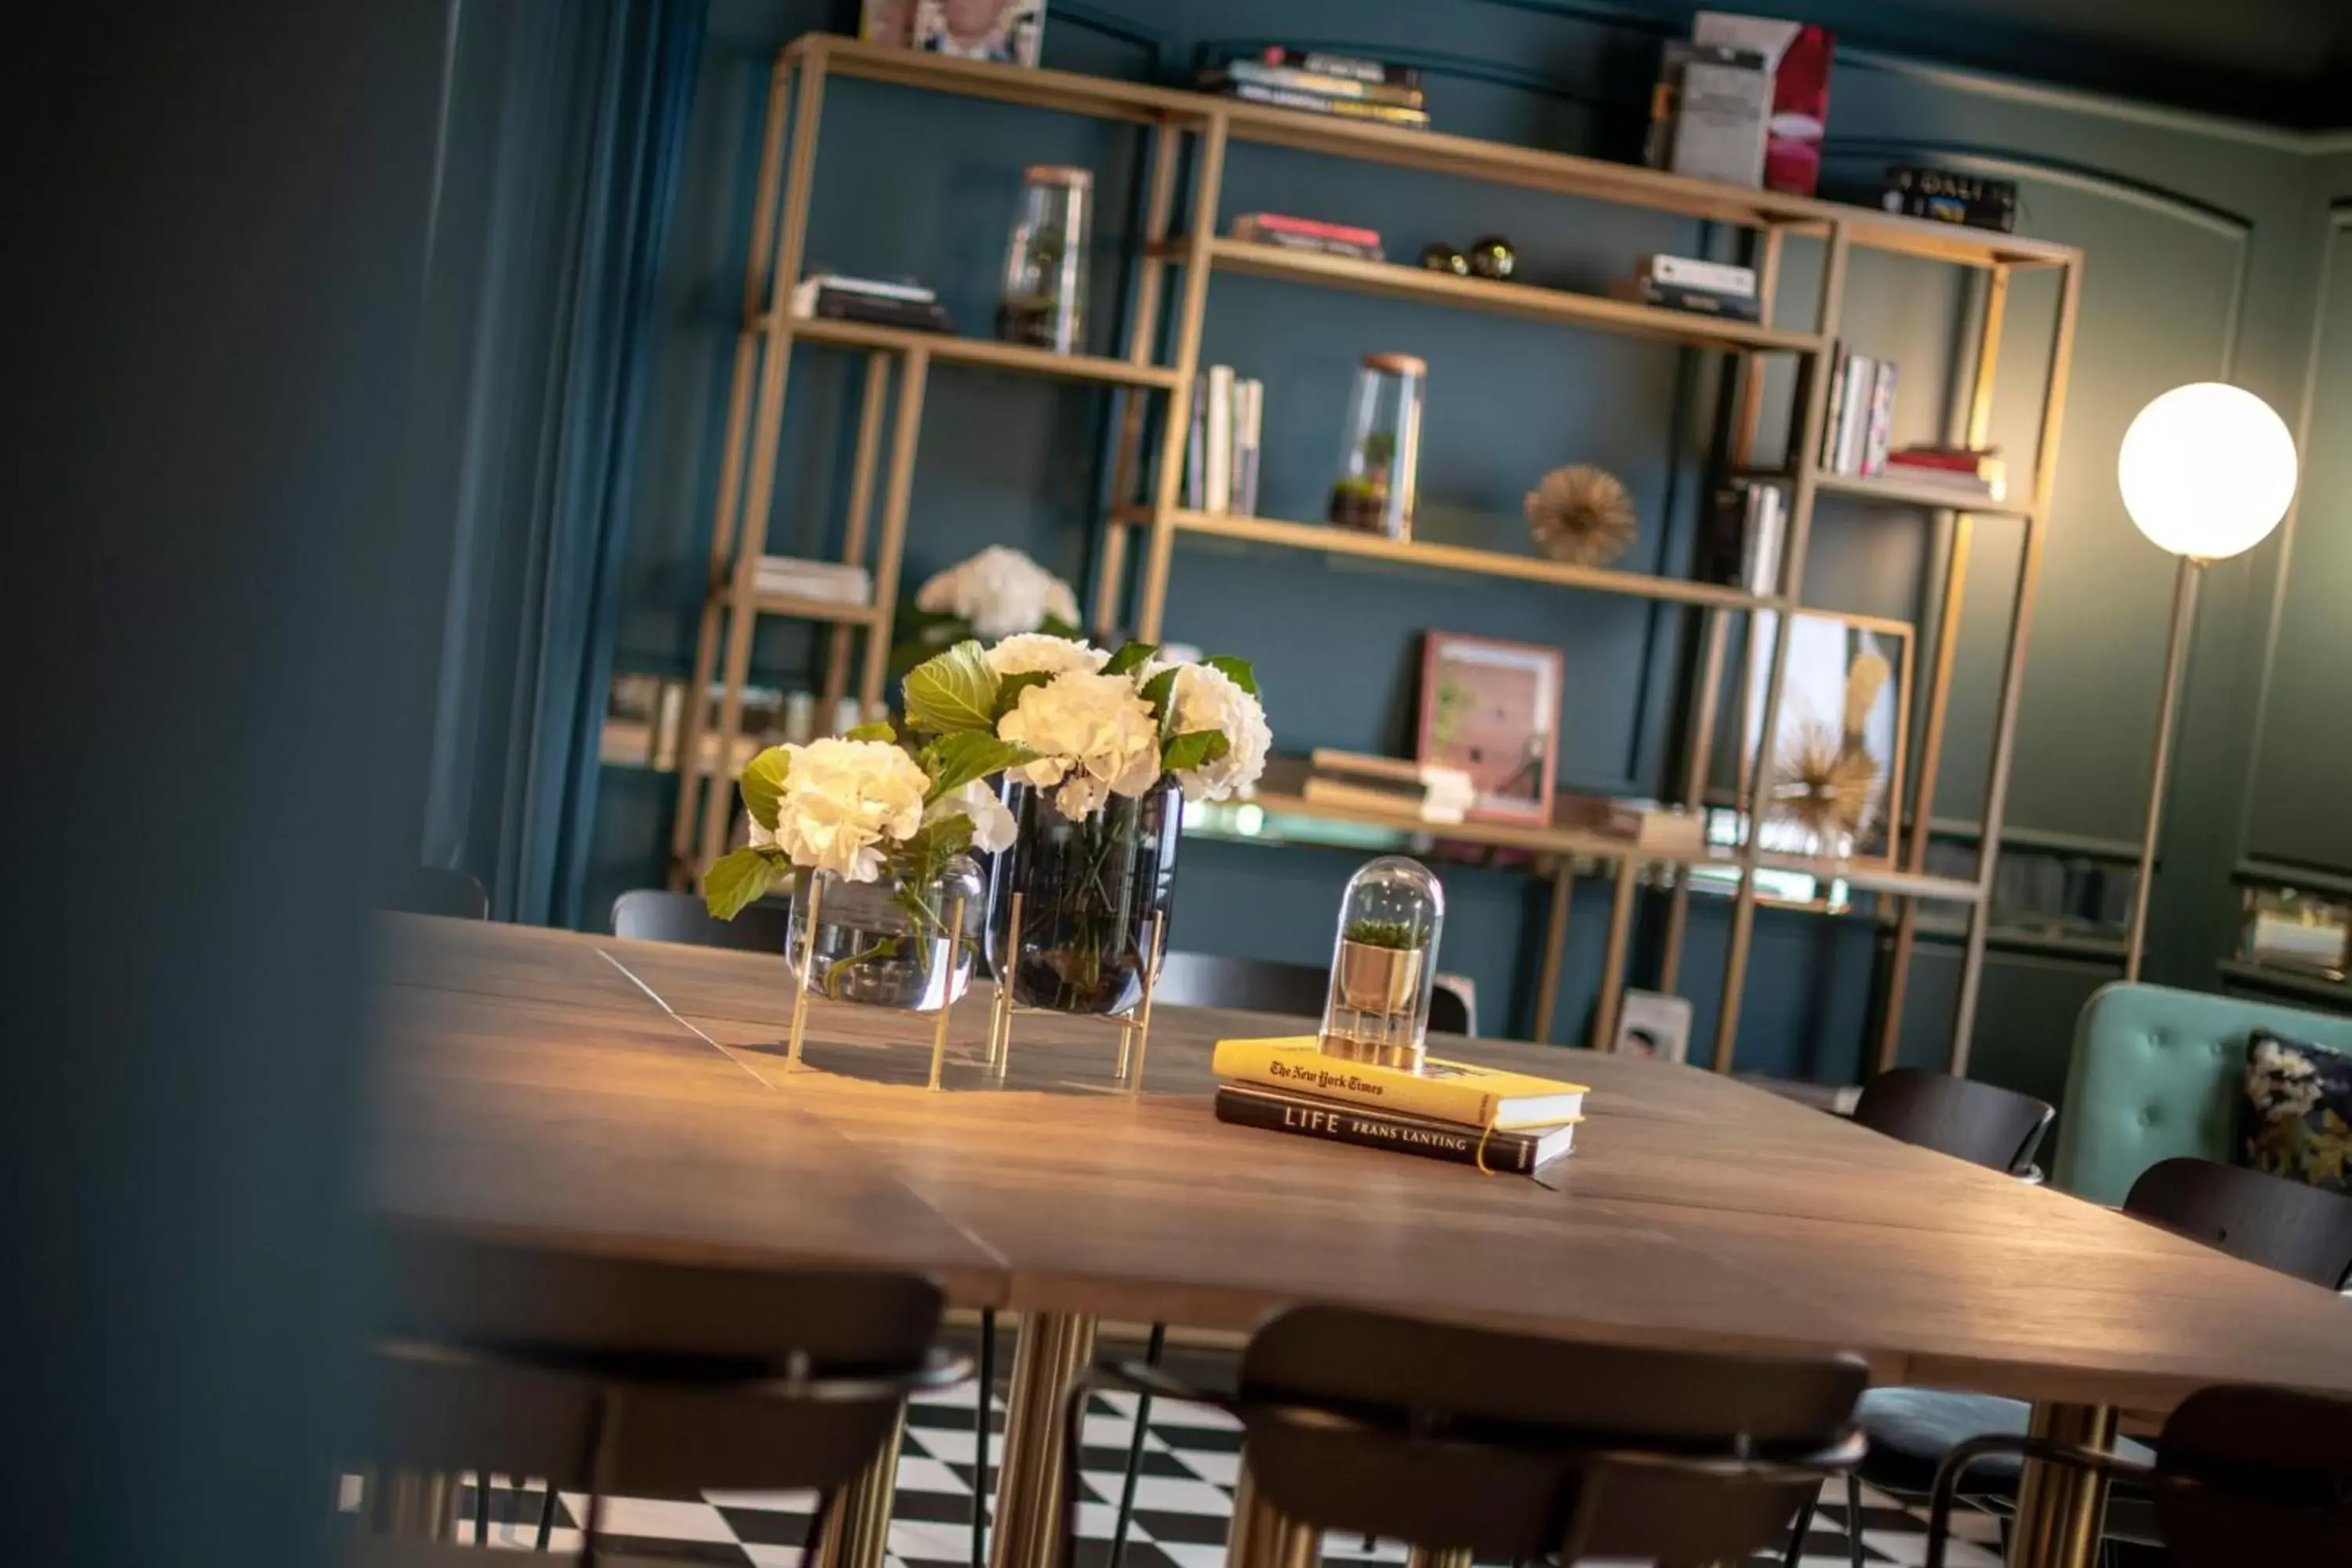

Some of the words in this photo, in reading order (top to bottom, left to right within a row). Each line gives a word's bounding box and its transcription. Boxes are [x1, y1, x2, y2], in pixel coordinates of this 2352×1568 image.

[1270, 1061, 1291, 1077] The
[1291, 1065, 1317, 1082] New
[1317, 1069, 1346, 1088] York
[1348, 1076, 1384, 1095] Times
[1284, 1106, 1341, 1134] LIFE
[1352, 1122, 1397, 1140] FRANS
[1403, 1130, 1467, 1151] LANTING
